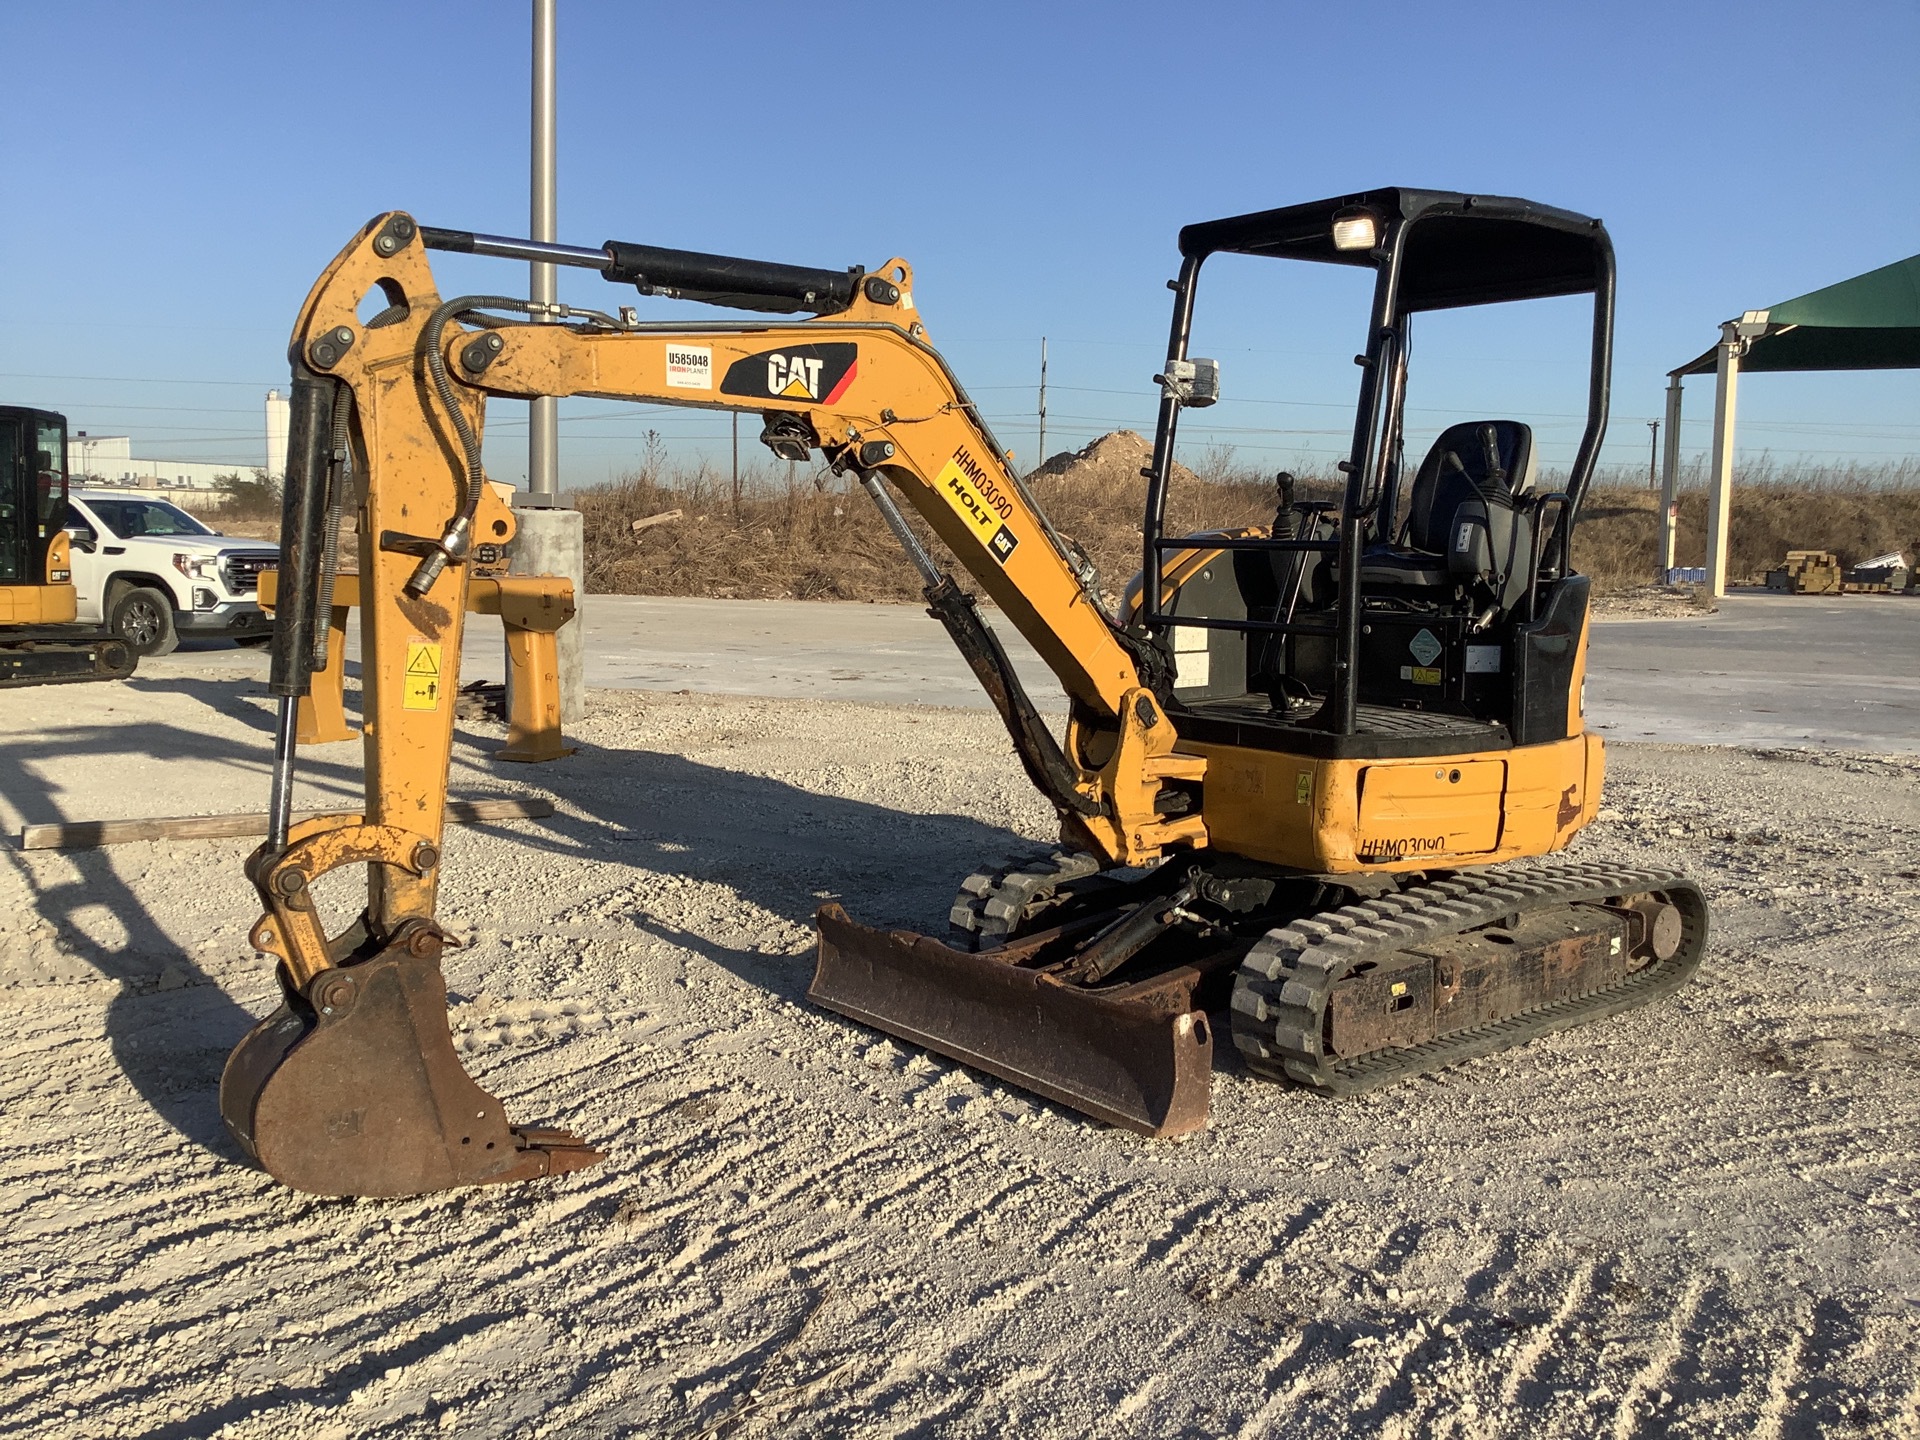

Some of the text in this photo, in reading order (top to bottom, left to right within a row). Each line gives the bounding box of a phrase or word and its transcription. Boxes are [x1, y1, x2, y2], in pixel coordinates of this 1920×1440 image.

[669, 352, 708, 367] U585048
[768, 353, 823, 399] CAT
[952, 444, 1013, 520] HHM03090
[948, 477, 1013, 554] HOLT CAT
[1360, 836, 1445, 856] HHM03090
